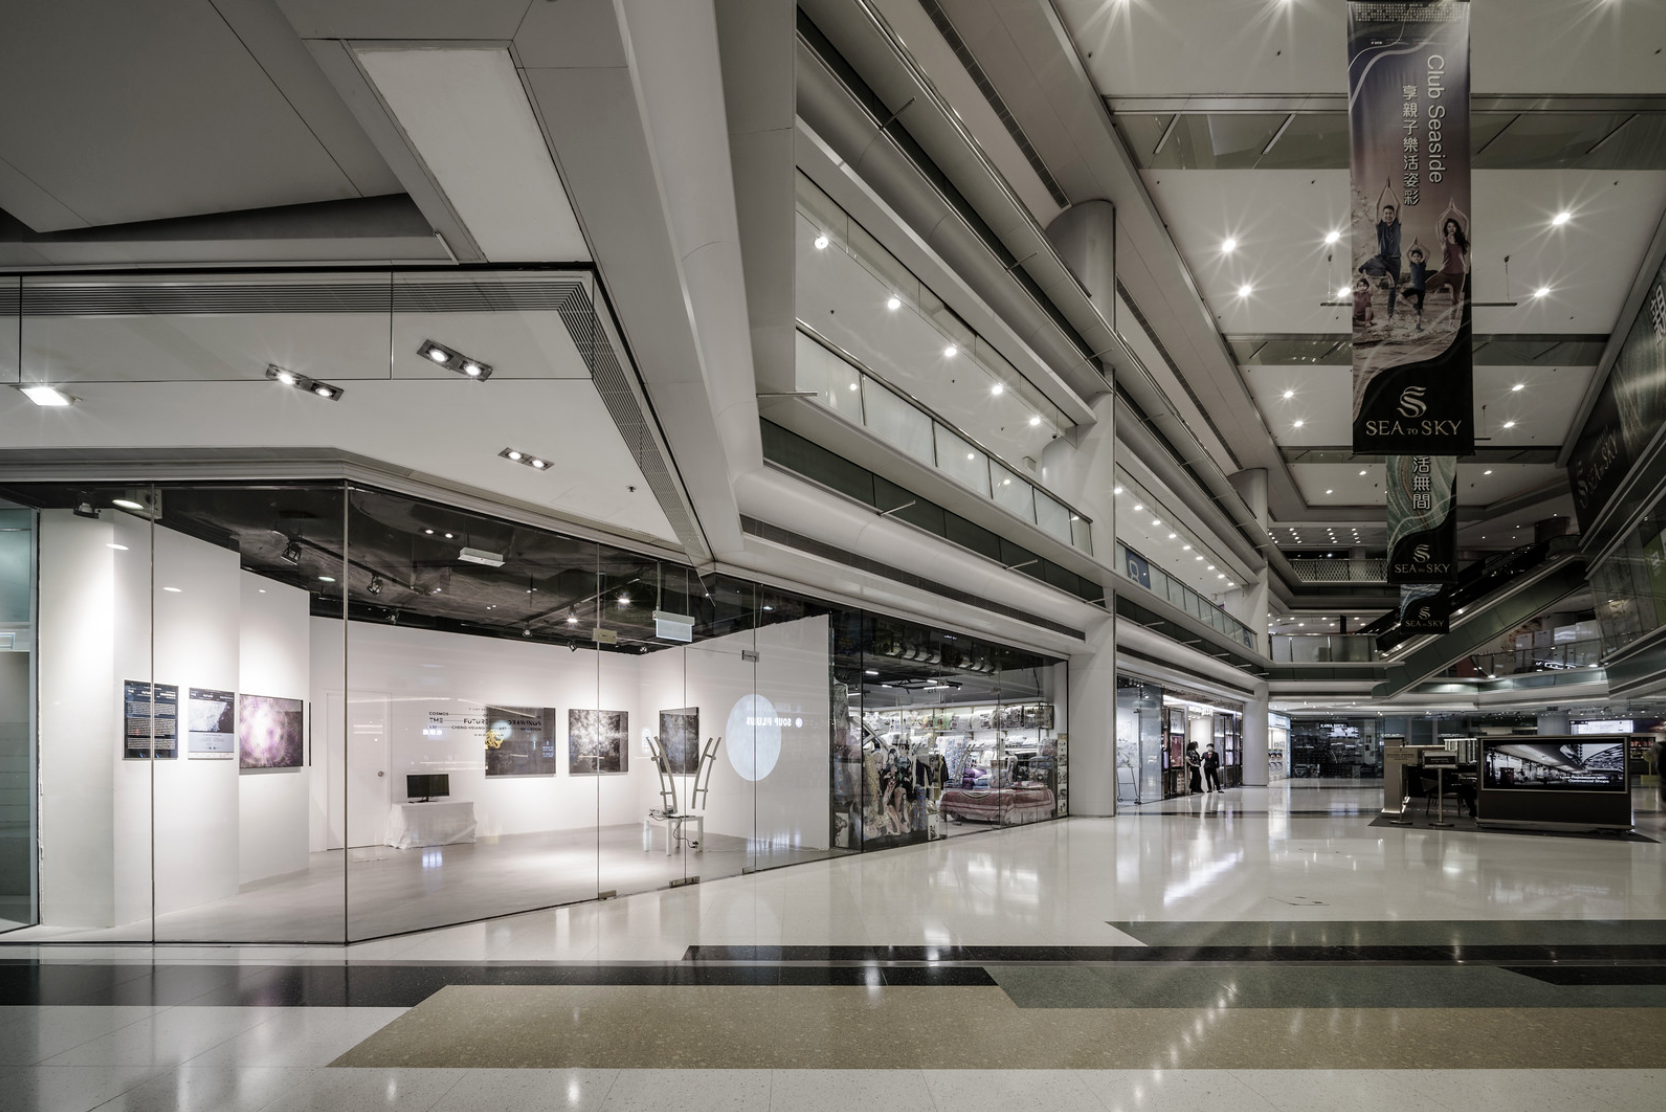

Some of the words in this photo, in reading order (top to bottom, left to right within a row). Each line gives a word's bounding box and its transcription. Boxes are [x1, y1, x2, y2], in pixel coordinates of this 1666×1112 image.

[1427, 54, 1446, 100] Club
[1402, 84, 1420, 206] 享親子樂活姿彩
[1428, 104, 1447, 184] Seaside
[1365, 419, 1404, 436] SEA
[1407, 427, 1418, 435] TO
[1421, 419, 1462, 436] SKY
[1413, 456, 1431, 510] 活無間
[1394, 563, 1418, 574] SEA
[1426, 563, 1451, 574] SKY
